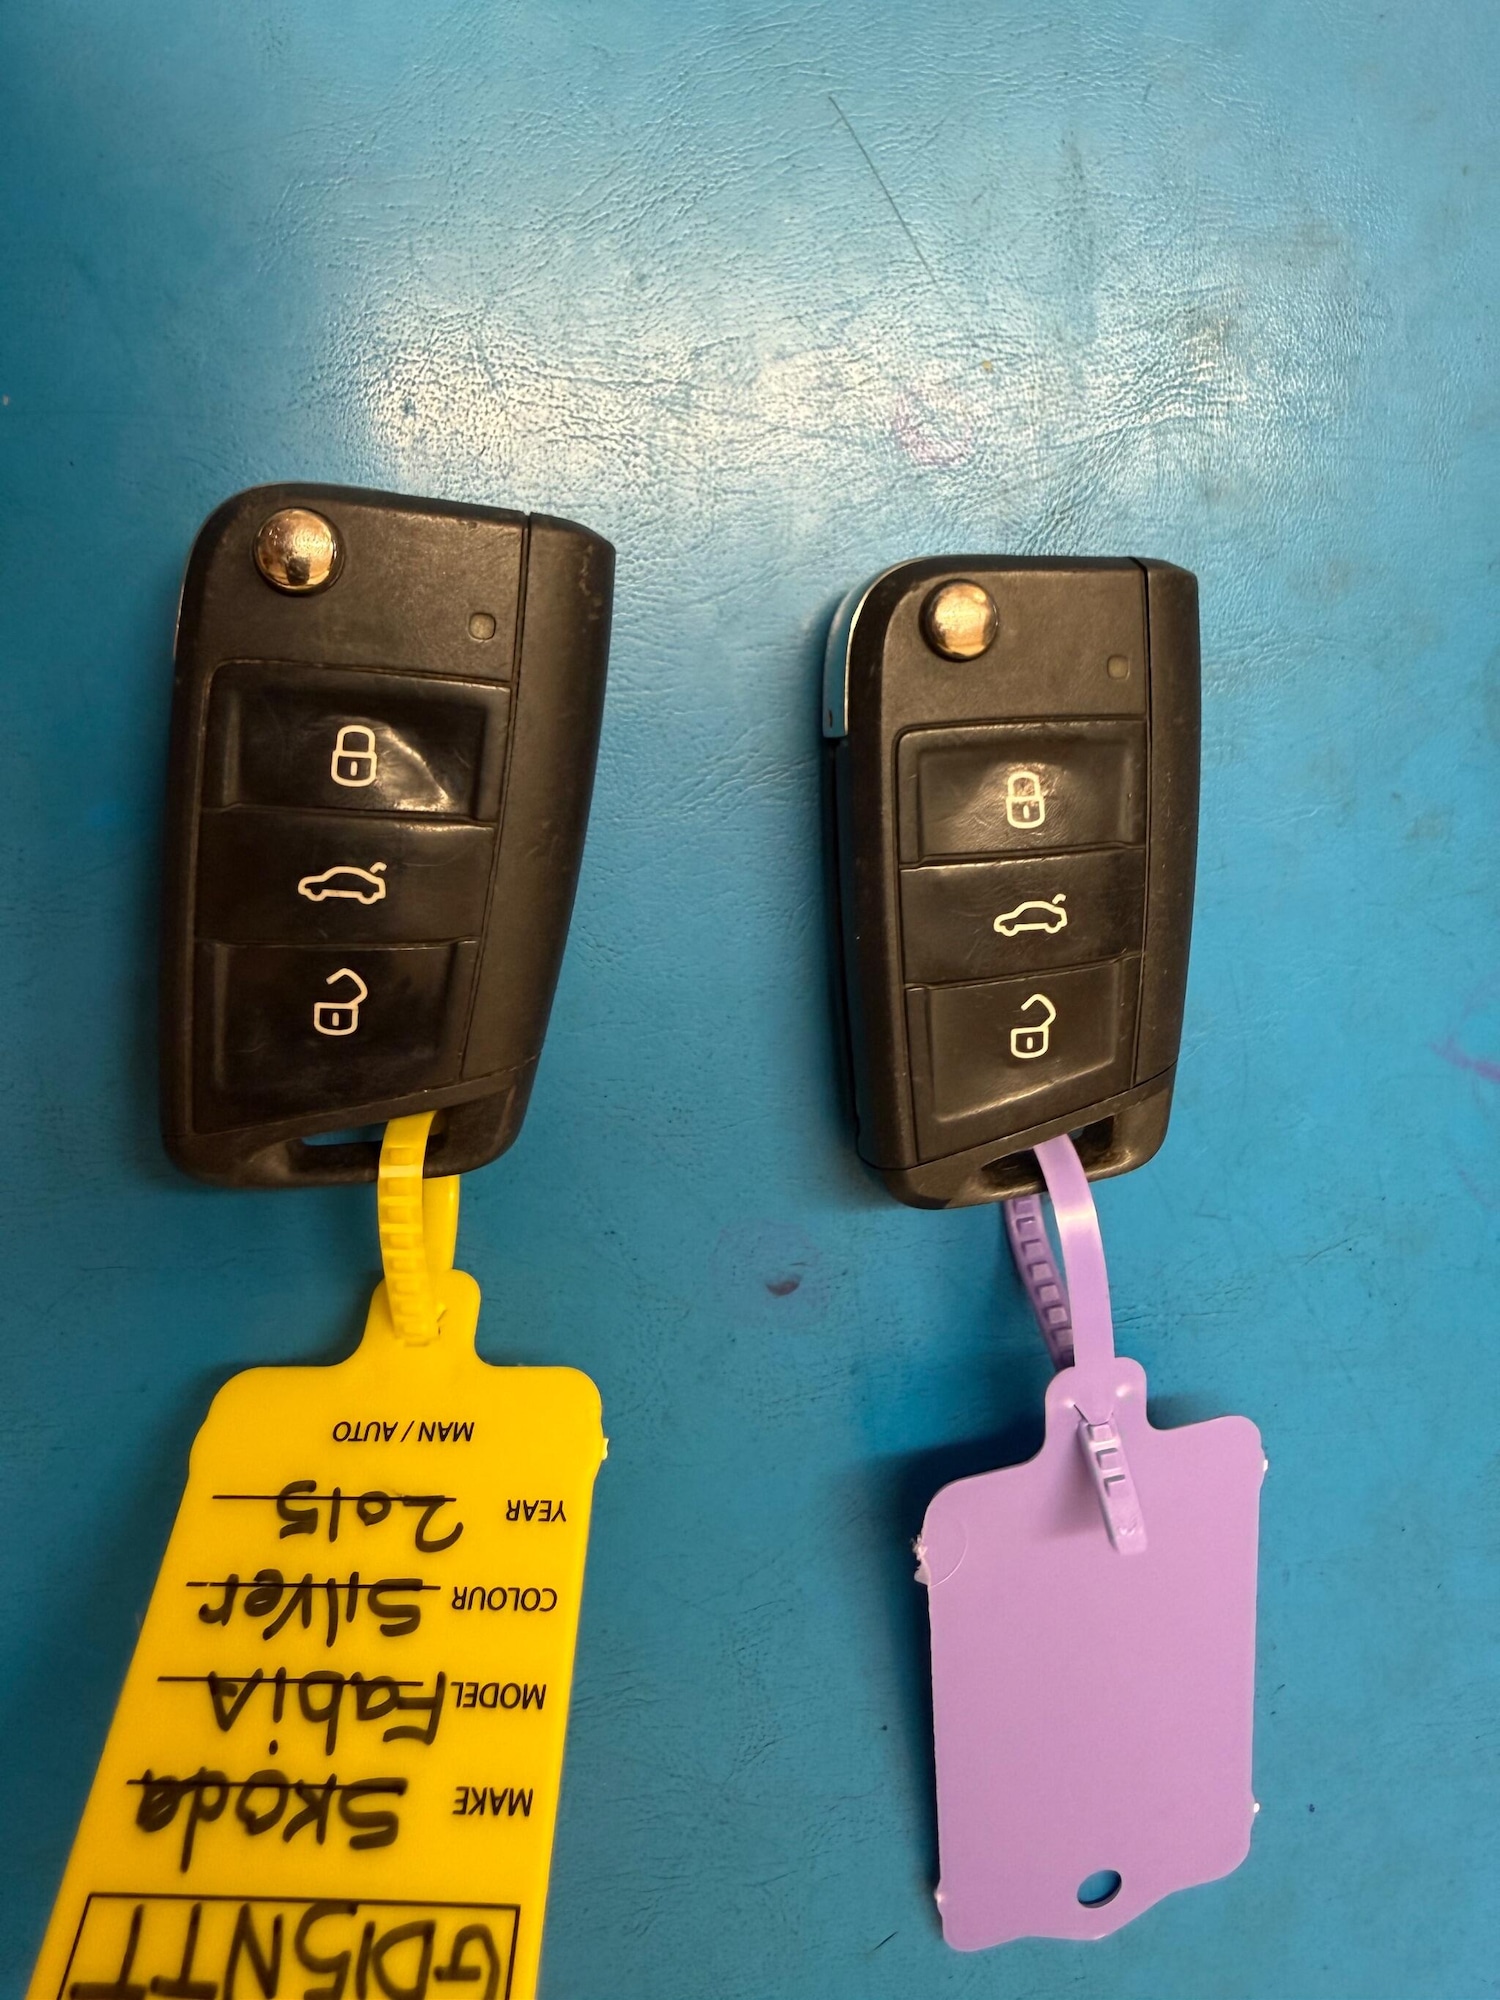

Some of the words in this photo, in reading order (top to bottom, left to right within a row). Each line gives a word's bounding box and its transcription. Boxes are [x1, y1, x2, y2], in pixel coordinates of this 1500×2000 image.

[333, 1420, 398, 1442] AUTO
[401, 1419, 415, 1443] /
[419, 1421, 475, 1442] MAN
[276, 1480, 464, 1553] 2015
[505, 1499, 566, 1522] YEAR
[452, 1586, 558, 1612] COLOUR
[450, 1682, 546, 1710] MODEL
[452, 1786, 534, 1817] MAKE
